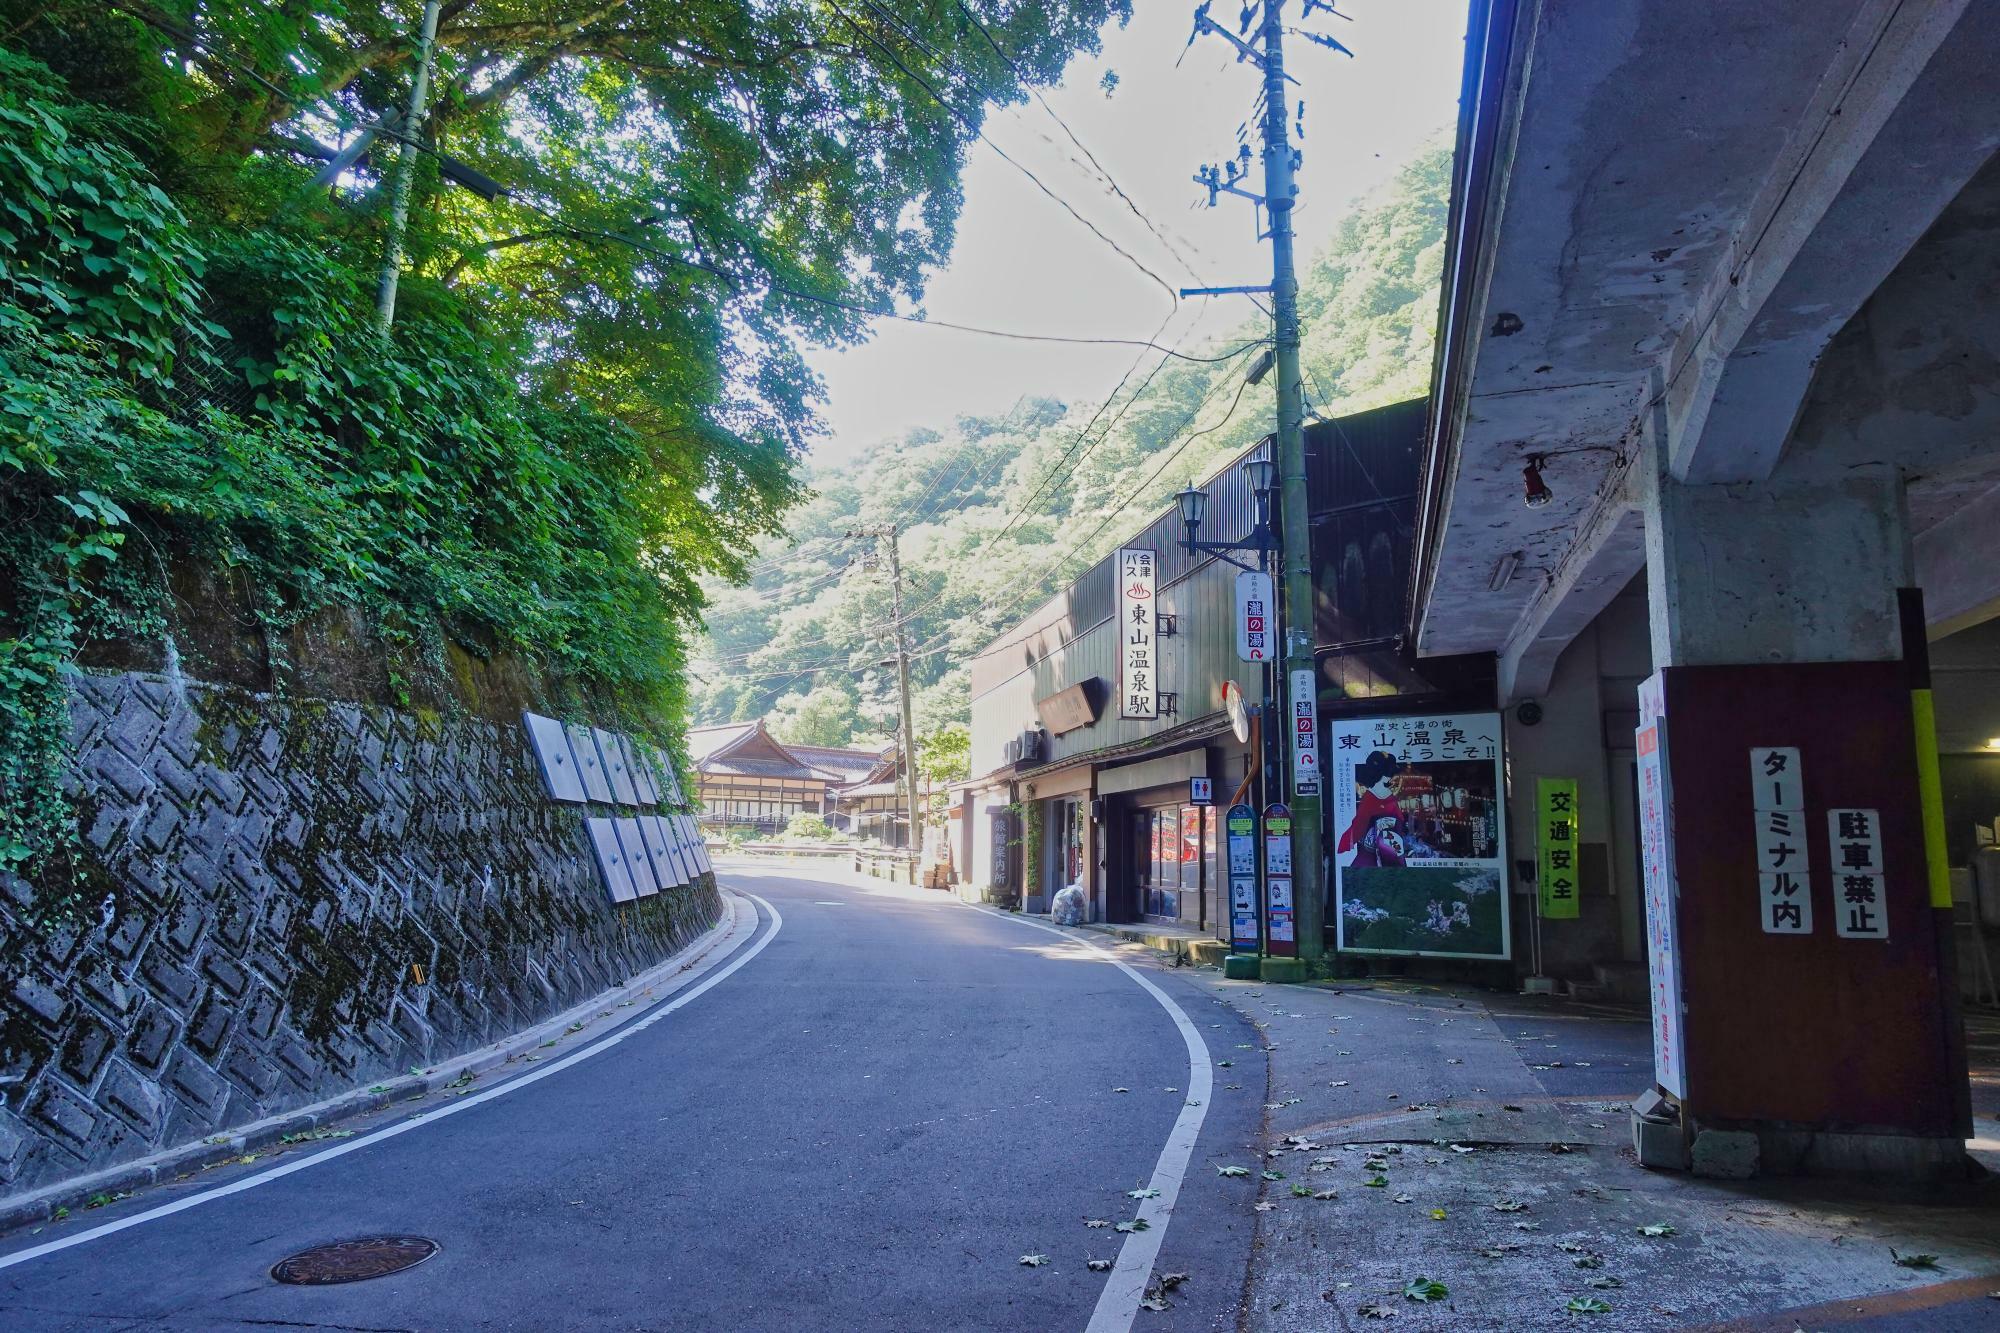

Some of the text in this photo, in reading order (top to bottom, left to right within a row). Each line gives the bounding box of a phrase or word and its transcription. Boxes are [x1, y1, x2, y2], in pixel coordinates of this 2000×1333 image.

[1126, 554, 1138, 577] バス
[1139, 554, 1151, 577] 会津
[1248, 601, 1263, 647] 瀧の湯
[1128, 604, 1151, 714] 東山温泉駅
[1297, 702, 1313, 748] 瀧の湯
[1338, 729, 1495, 749] 東山温泉へ
[994, 819, 1006, 885] 旅館案内所
[1550, 792, 1572, 899] 交通安全
[1763, 750, 1802, 930] ターミナル内
[1838, 811, 1878, 933] 駐車禁止
